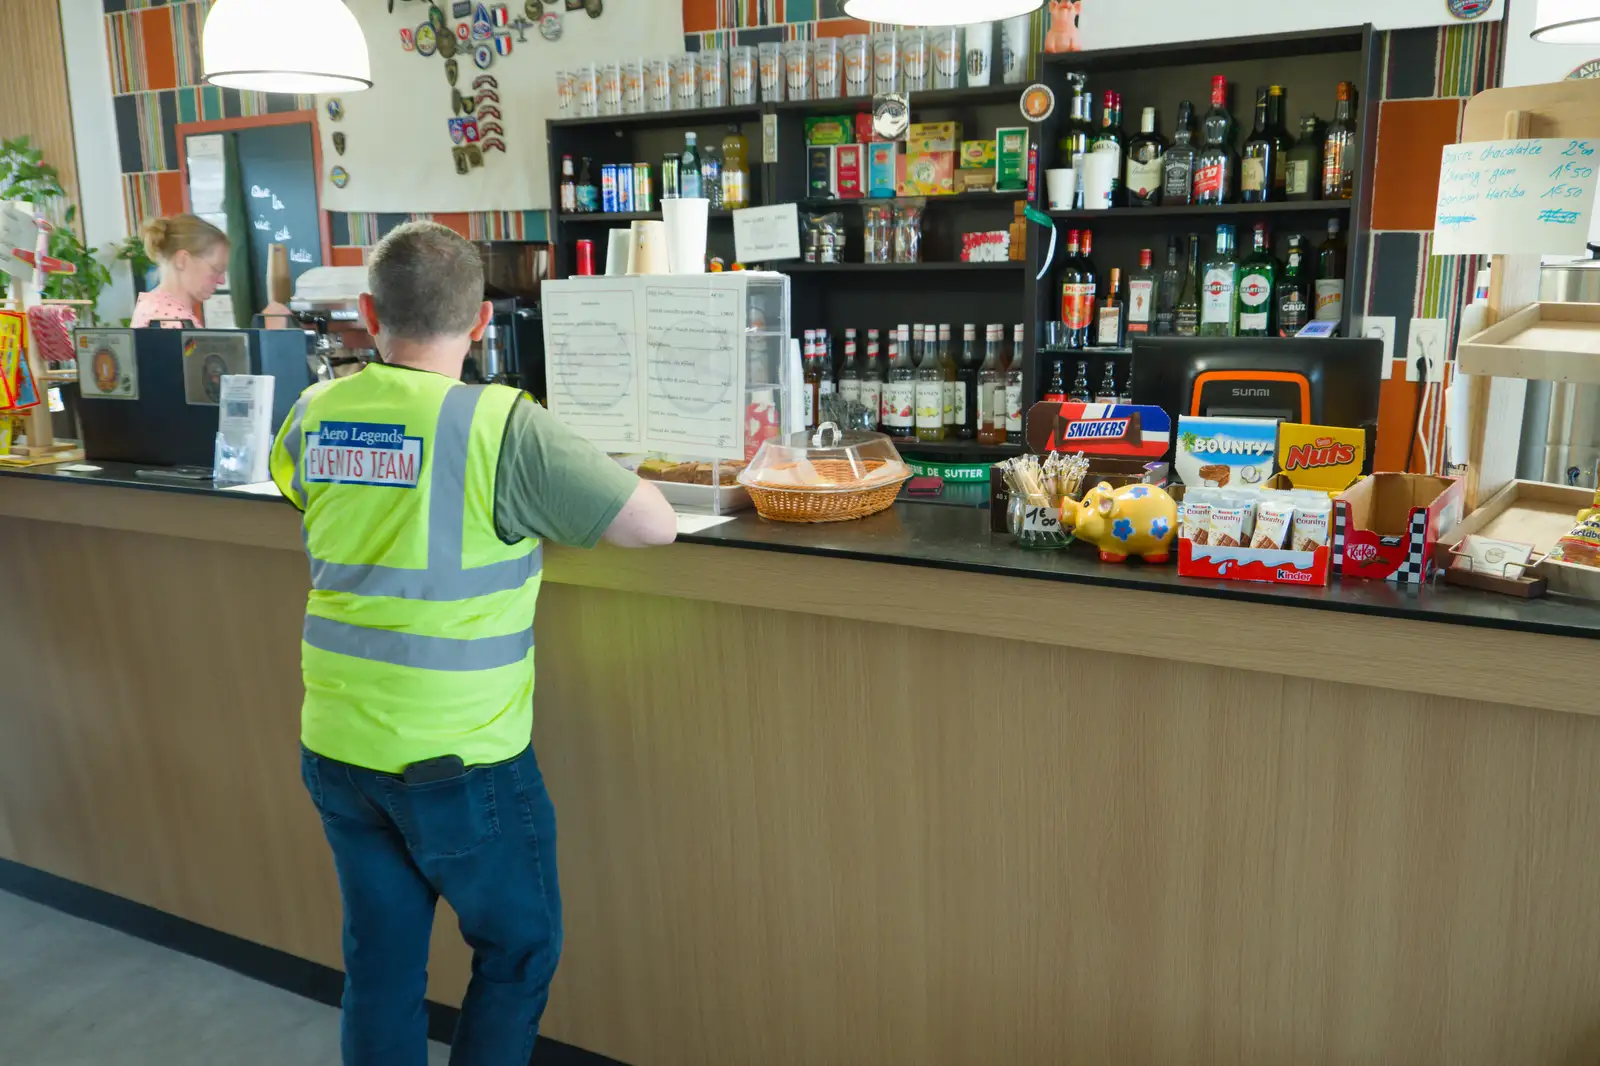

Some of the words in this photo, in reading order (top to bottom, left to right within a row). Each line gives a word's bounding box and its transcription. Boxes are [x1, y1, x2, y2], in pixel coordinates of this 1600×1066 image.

[320, 426, 348, 441] Aero
[351, 427, 404, 445] Legends
[1067, 420, 1127, 439] SNICKERS
[1194, 438, 1269, 457] BOUNTY
[1286, 442, 1355, 471] Nuts
[310, 448, 363, 478] EVENTS
[369, 451, 414, 481] TEAM
[927, 467, 939, 477] DE
[944, 468, 983, 478] SUTTER
